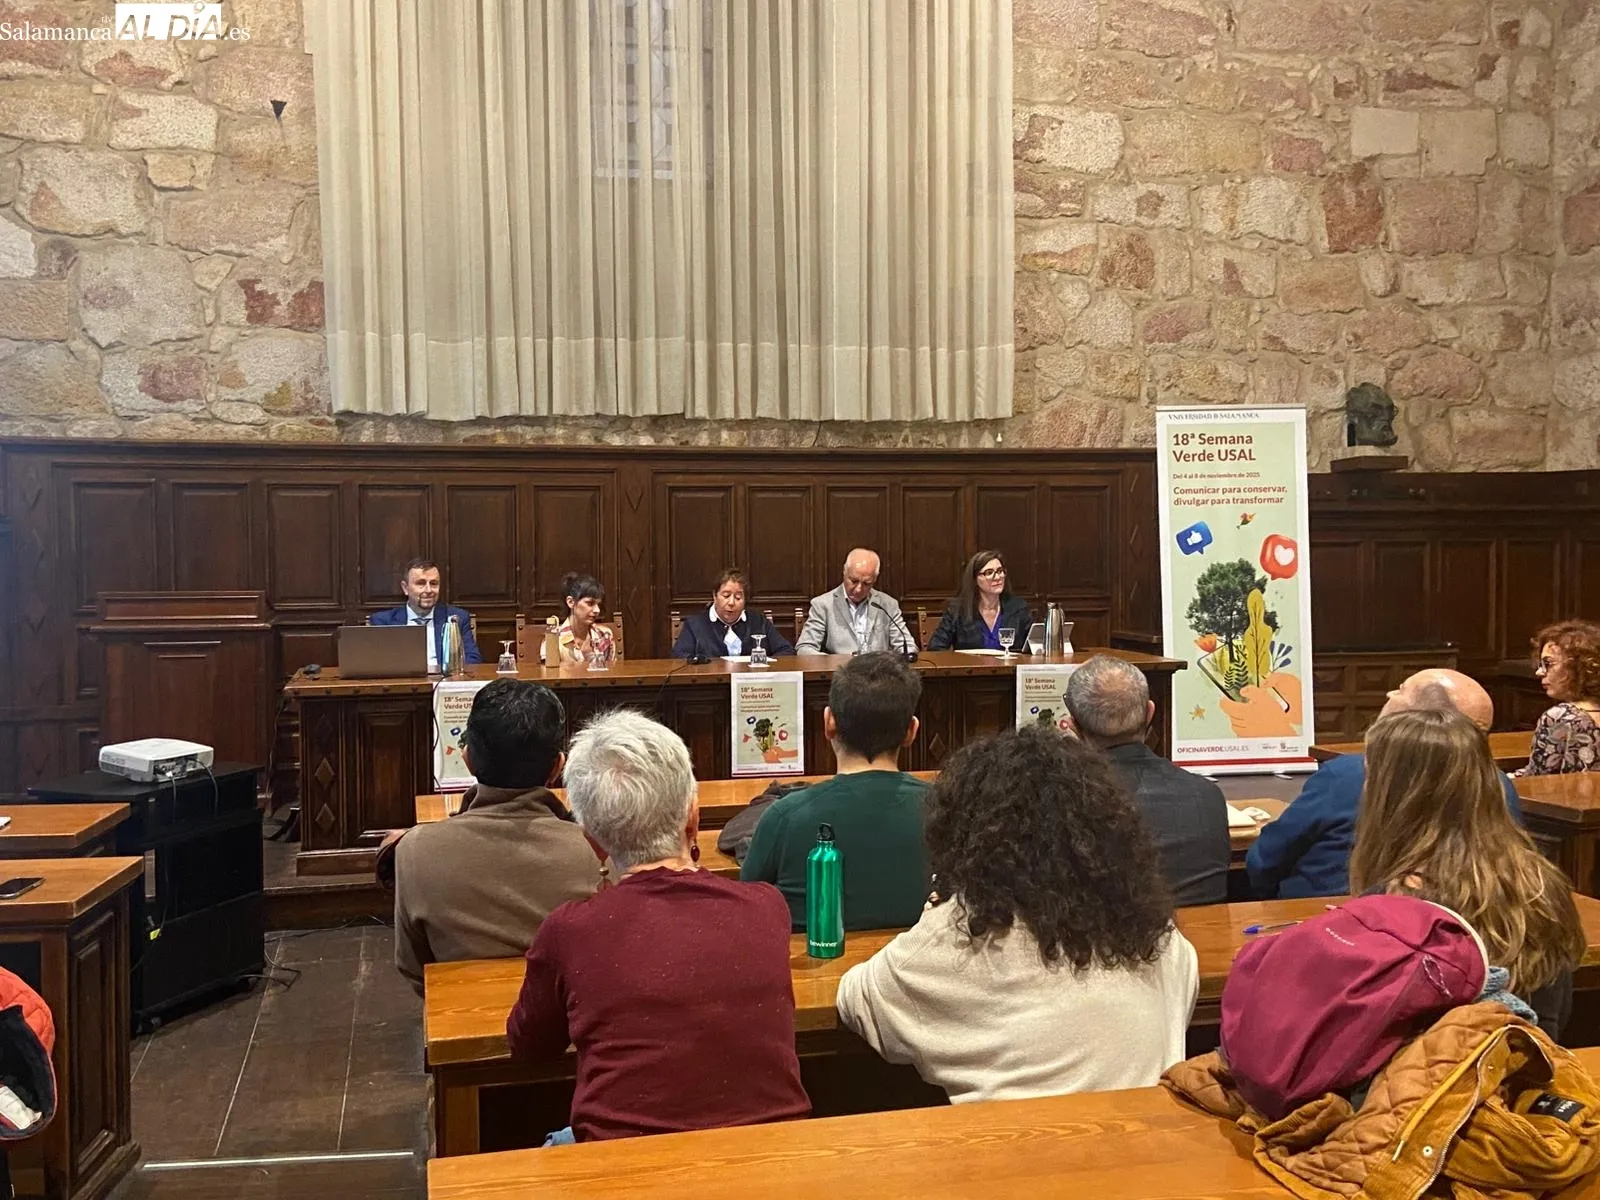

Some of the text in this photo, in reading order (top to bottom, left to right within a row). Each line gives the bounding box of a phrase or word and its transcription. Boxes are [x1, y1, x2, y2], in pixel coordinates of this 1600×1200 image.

[1172, 433, 1253, 446] 18ª Semana
[1172, 448, 1256, 463] Verde USAL
[1173, 485, 1288, 495] Comunicar para conservar,
[1173, 496, 1284, 507] divulgar para transformar
